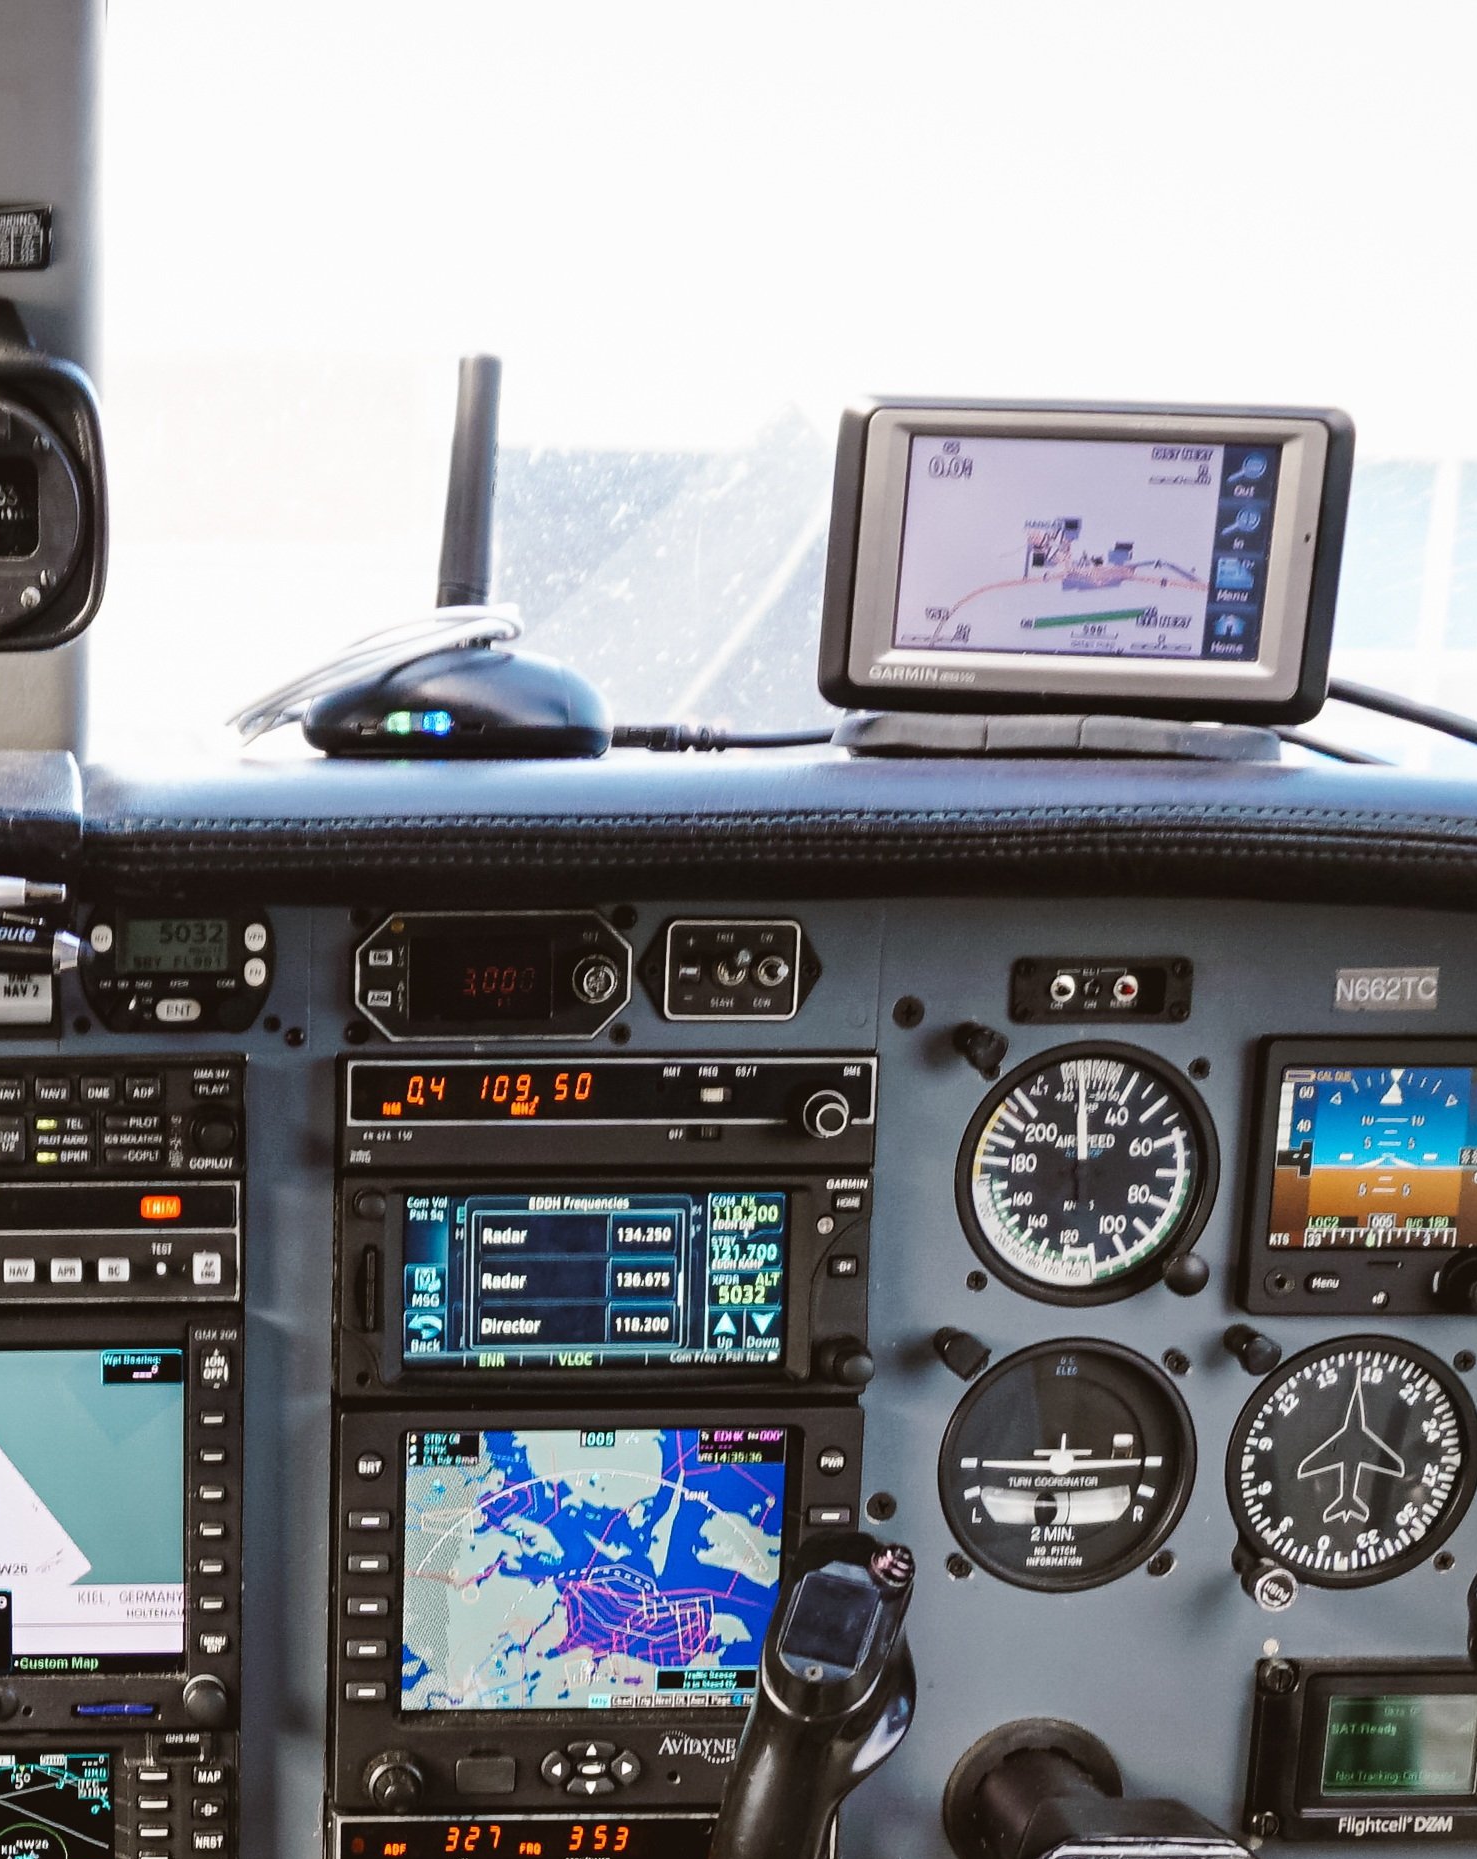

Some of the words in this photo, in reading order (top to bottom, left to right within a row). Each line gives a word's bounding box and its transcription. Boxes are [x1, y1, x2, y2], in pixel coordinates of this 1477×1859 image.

[1216, 590, 1247, 602] Menu
[1210, 641, 1243, 654] Home
[869, 666, 938, 682] GARMIN
[159, 924, 224, 944] 5032
[1337, 978, 1437, 1001] N662TC
[128, 1117, 159, 1128] PILOT
[1104, 1106, 1129, 1127] 40
[1025, 1121, 1057, 1143] 200
[1129, 1136, 1152, 1157] 60
[190, 1158, 233, 1169] COPILOT
[1011, 1152, 1037, 1173] 180
[826, 1178, 868, 1190] GARMIN
[1012, 1190, 1032, 1207] 160
[1128, 1183, 1150, 1204] 80
[564, 1197, 629, 1211] Frequencies
[1099, 1213, 1127, 1234] 100
[483, 1227, 527, 1244] Radar
[1270, 1233, 1290, 1246] KTS
[152, 1243, 172, 1255] TEST
[483, 1272, 527, 1289] Radar
[756, 1271, 780, 1287] ALT
[1312, 1276, 1339, 1290] Menu
[413, 1294, 439, 1307] MSG
[482, 1317, 541, 1335] Director
[412, 1338, 440, 1352] Back
[748, 1336, 779, 1349] Down
[559, 1352, 592, 1366] VLOC
[359, 1459, 381, 1473] BAT
[821, 1455, 843, 1469] PWR
[1031, 1527, 1040, 1542] 2
[1044, 1526, 1075, 1542] MIN.
[1053, 1546, 1077, 1557] PITCH
[1026, 1556, 1082, 1567] INFORMATION
[119, 1591, 184, 1604] GERMANY
[20, 1657, 66, 1670] Custom
[70, 1656, 99, 1672] Map
[659, 1736, 737, 1758] AVIDYNE
[198, 1771, 221, 1784] MAP
[1414, 1815, 1453, 1833] DZM
[194, 1834, 222, 1849] NRST
[445, 1825, 502, 1852] 327
[569, 1825, 630, 1851] 353
[384, 1843, 407, 1856] ADF
